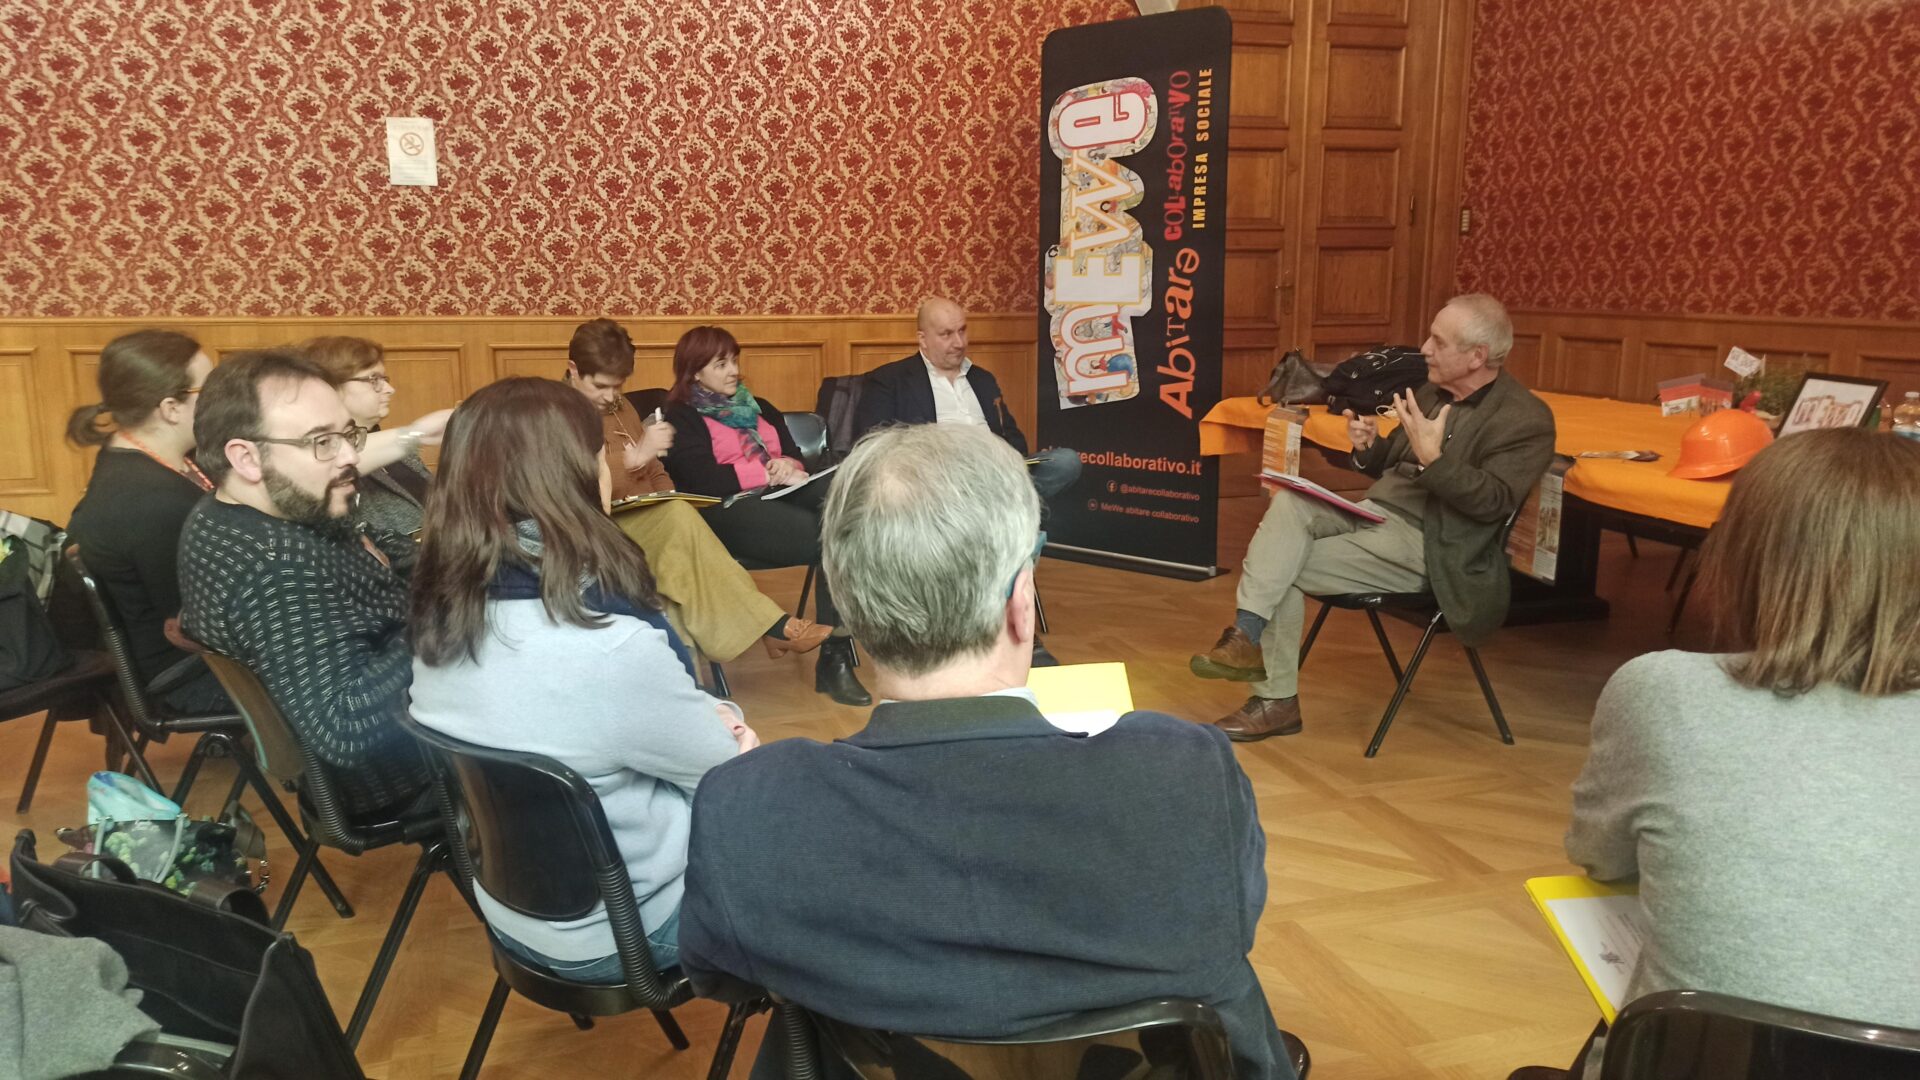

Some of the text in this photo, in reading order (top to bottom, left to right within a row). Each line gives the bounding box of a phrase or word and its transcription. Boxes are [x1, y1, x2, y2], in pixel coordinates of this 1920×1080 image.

[1192, 68, 1213, 229] IMPRESA SOCIALE
[1125, 506, 1151, 517] abitare
[1151, 510, 1200, 523] collaborativo
